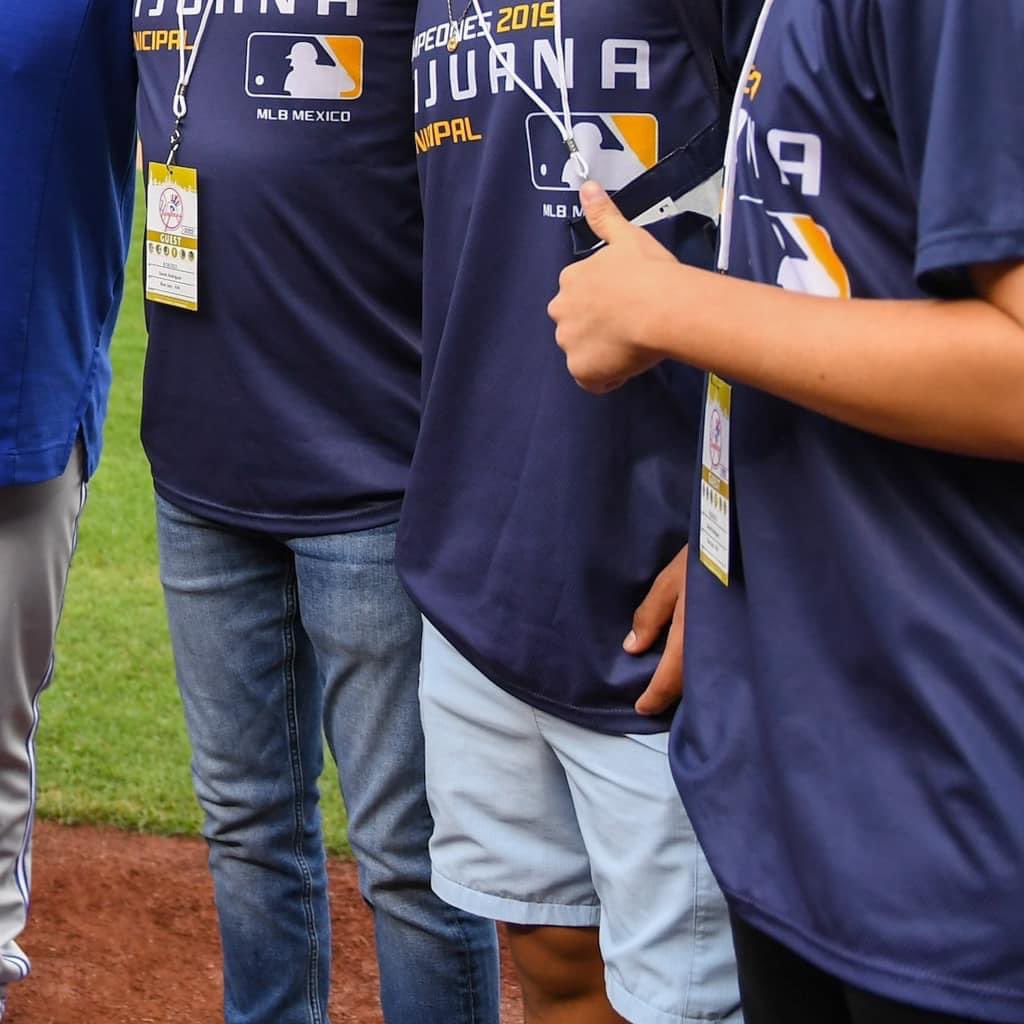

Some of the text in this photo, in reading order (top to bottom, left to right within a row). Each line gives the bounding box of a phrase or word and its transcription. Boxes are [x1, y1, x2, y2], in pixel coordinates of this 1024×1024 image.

[414, 37, 651, 114] IJUANA
[257, 108, 351, 123] MLB MEXICO
[159, 233, 183, 247] GUEST
